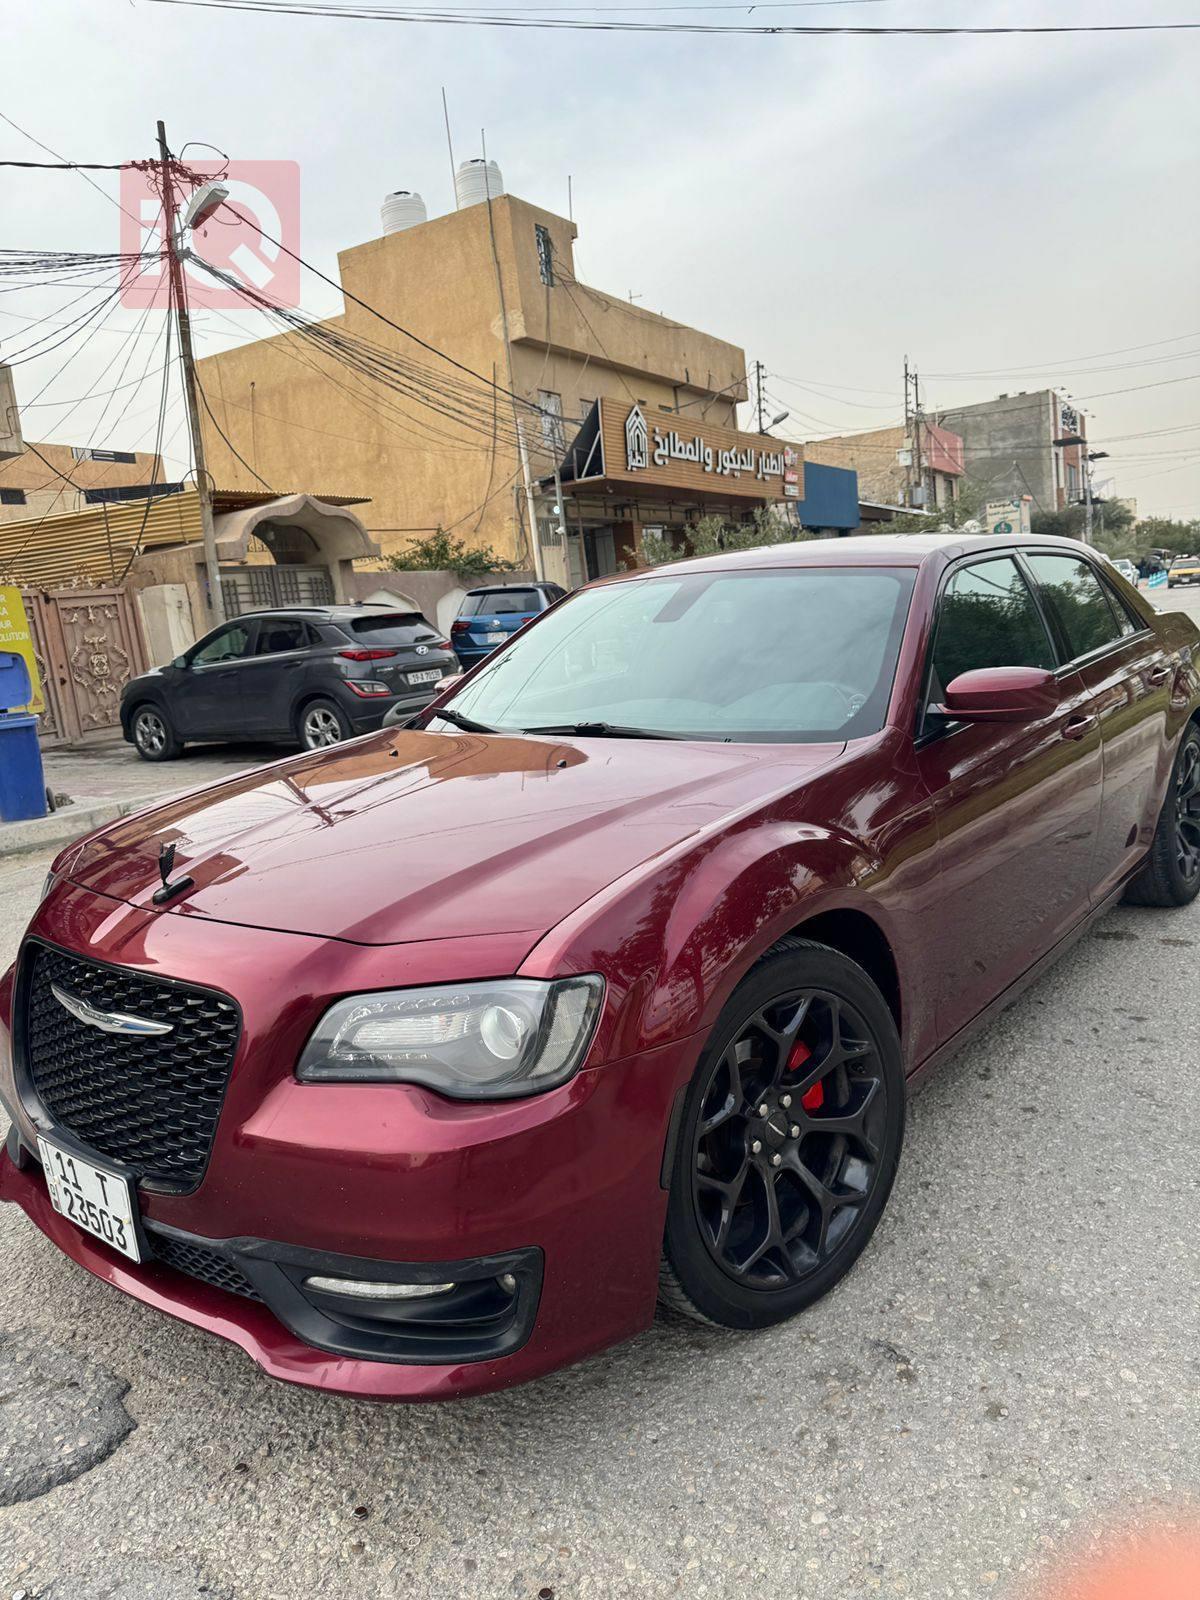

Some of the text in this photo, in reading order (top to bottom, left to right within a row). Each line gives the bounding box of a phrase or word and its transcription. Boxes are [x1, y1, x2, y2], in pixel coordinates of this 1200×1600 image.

[653, 427, 712, 472] والمطابخ
[716, 445, 755, 478] للديكور
[756, 451, 785, 480] الطيار
[55, 1152, 109, 1206] 11 T
[63, 1187, 127, 1250] 23503
